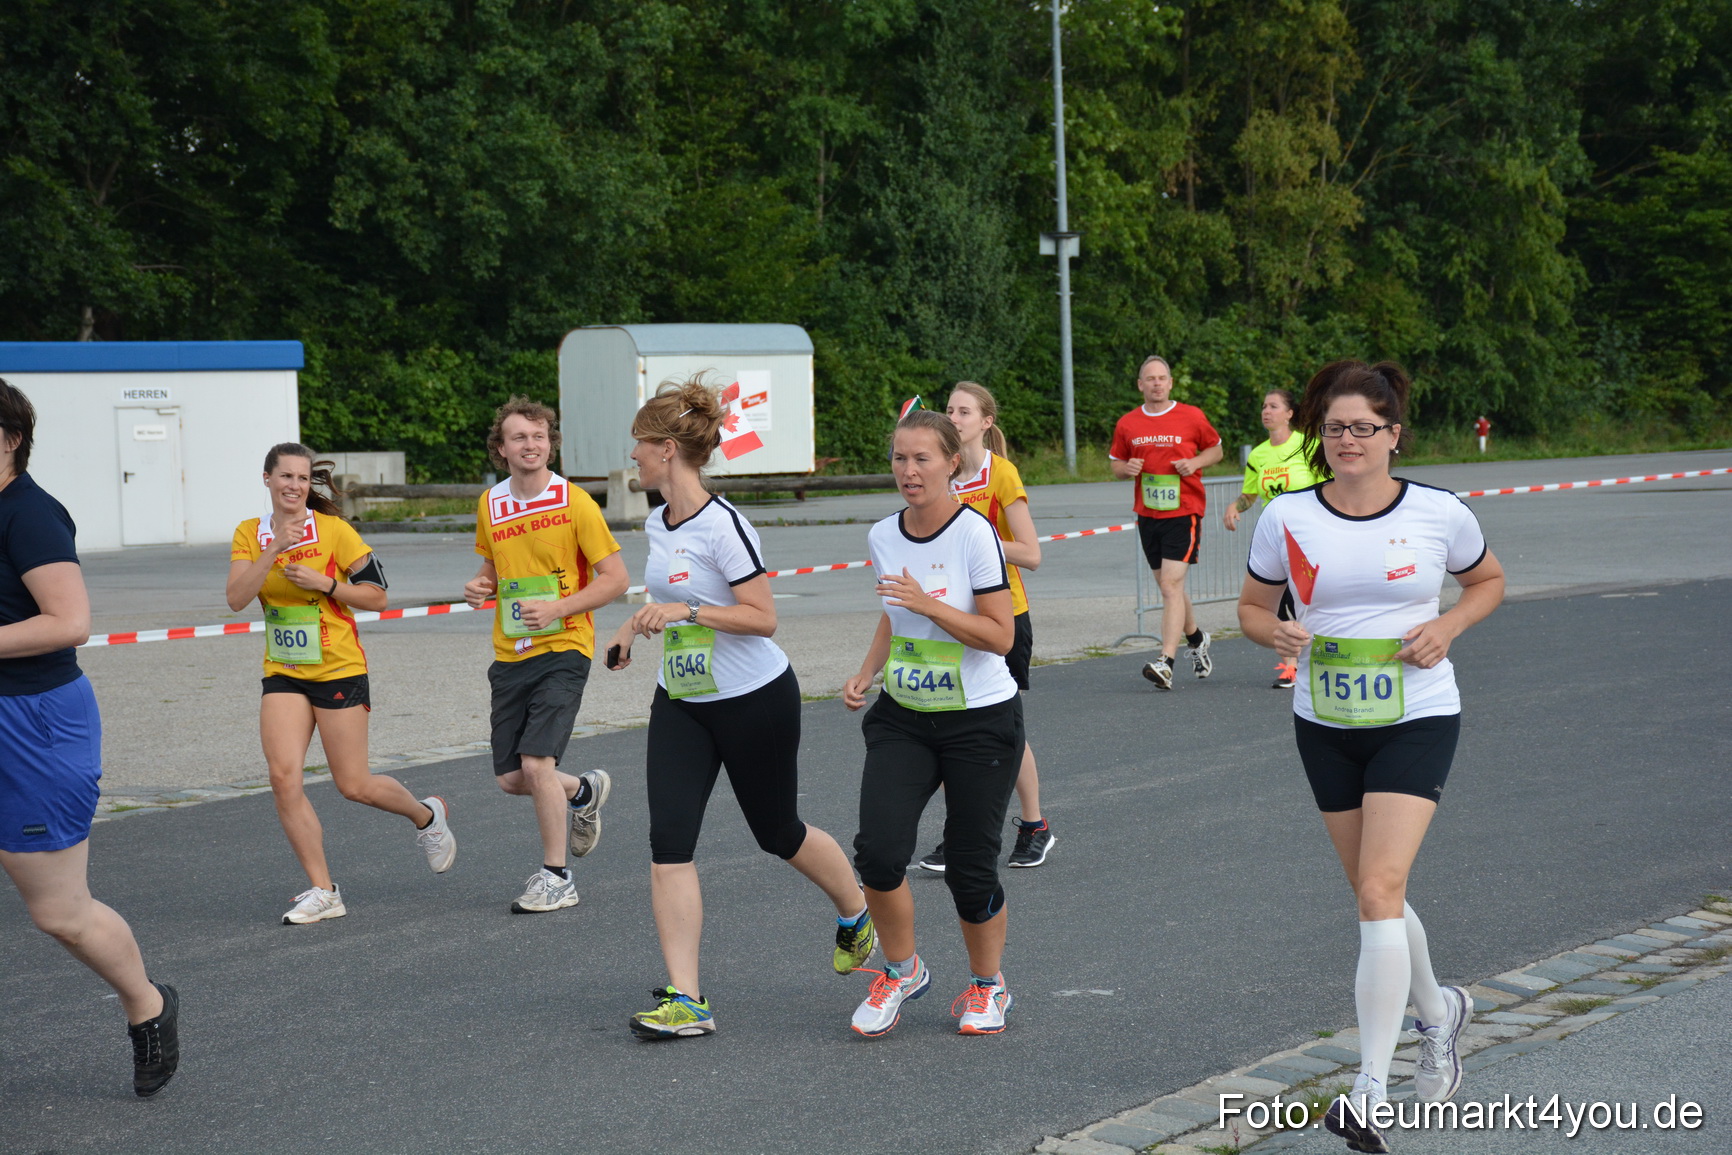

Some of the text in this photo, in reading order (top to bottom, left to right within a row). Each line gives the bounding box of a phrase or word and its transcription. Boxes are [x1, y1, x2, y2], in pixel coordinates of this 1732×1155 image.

[123, 389, 167, 399] HERREN
[1131, 435, 1174, 445] NEUMARKT
[1263, 467, 1289, 475] Müller
[963, 492, 989, 504] BÖGL
[1145, 487, 1176, 500] 1418
[492, 513, 572, 543] MAX BÖGL
[289, 548, 322, 564] BÖGL
[274, 629, 308, 648] 860
[667, 653, 706, 678] 1548
[893, 667, 955, 692] 1544
[1319, 671, 1393, 700] 1510
